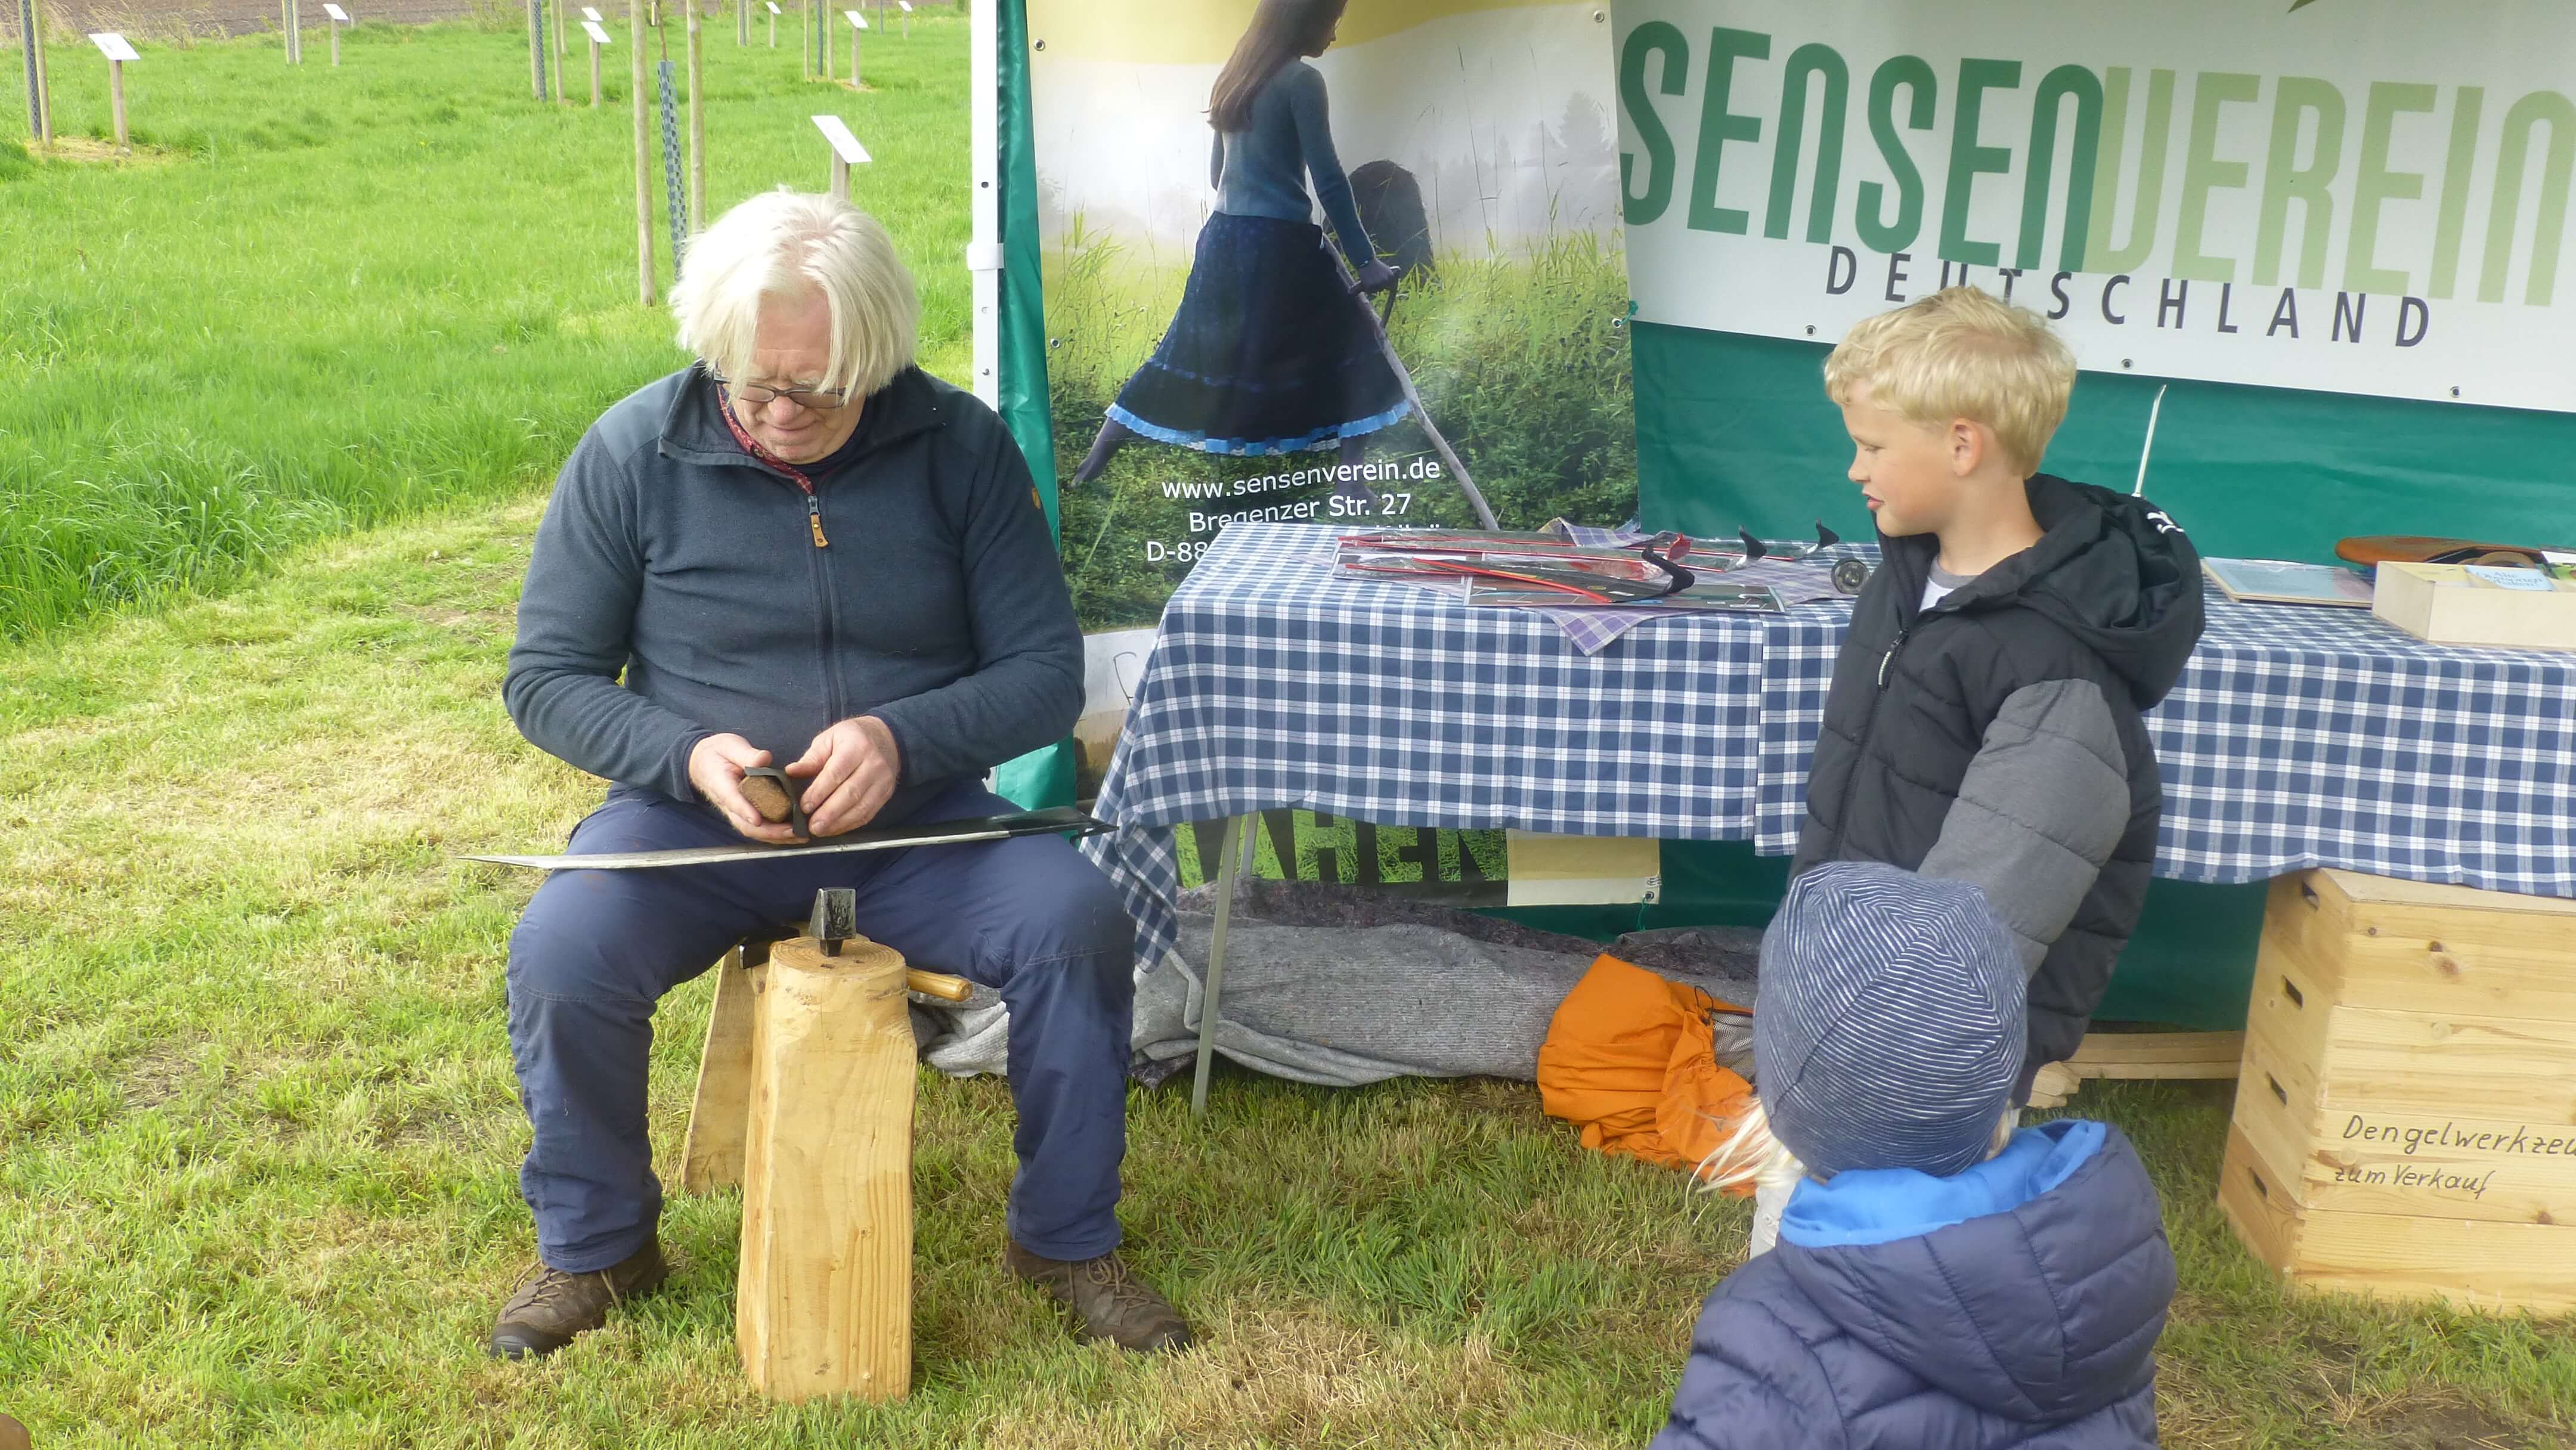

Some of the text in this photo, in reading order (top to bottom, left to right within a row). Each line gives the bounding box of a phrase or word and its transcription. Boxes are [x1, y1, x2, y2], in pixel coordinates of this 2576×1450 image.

[1619, 21, 2576, 306] SENSENVEREIN
[1825, 245, 2429, 348] DEUTSCHLAND
[1162, 457, 1441, 498] www.sensenverein.de
[1329, 495, 1370, 518] Str.
[1381, 493, 1412, 516] 27
[1146, 541, 1208, 562] D-88
[2334, 1164, 2496, 1200] zum Verkauf
